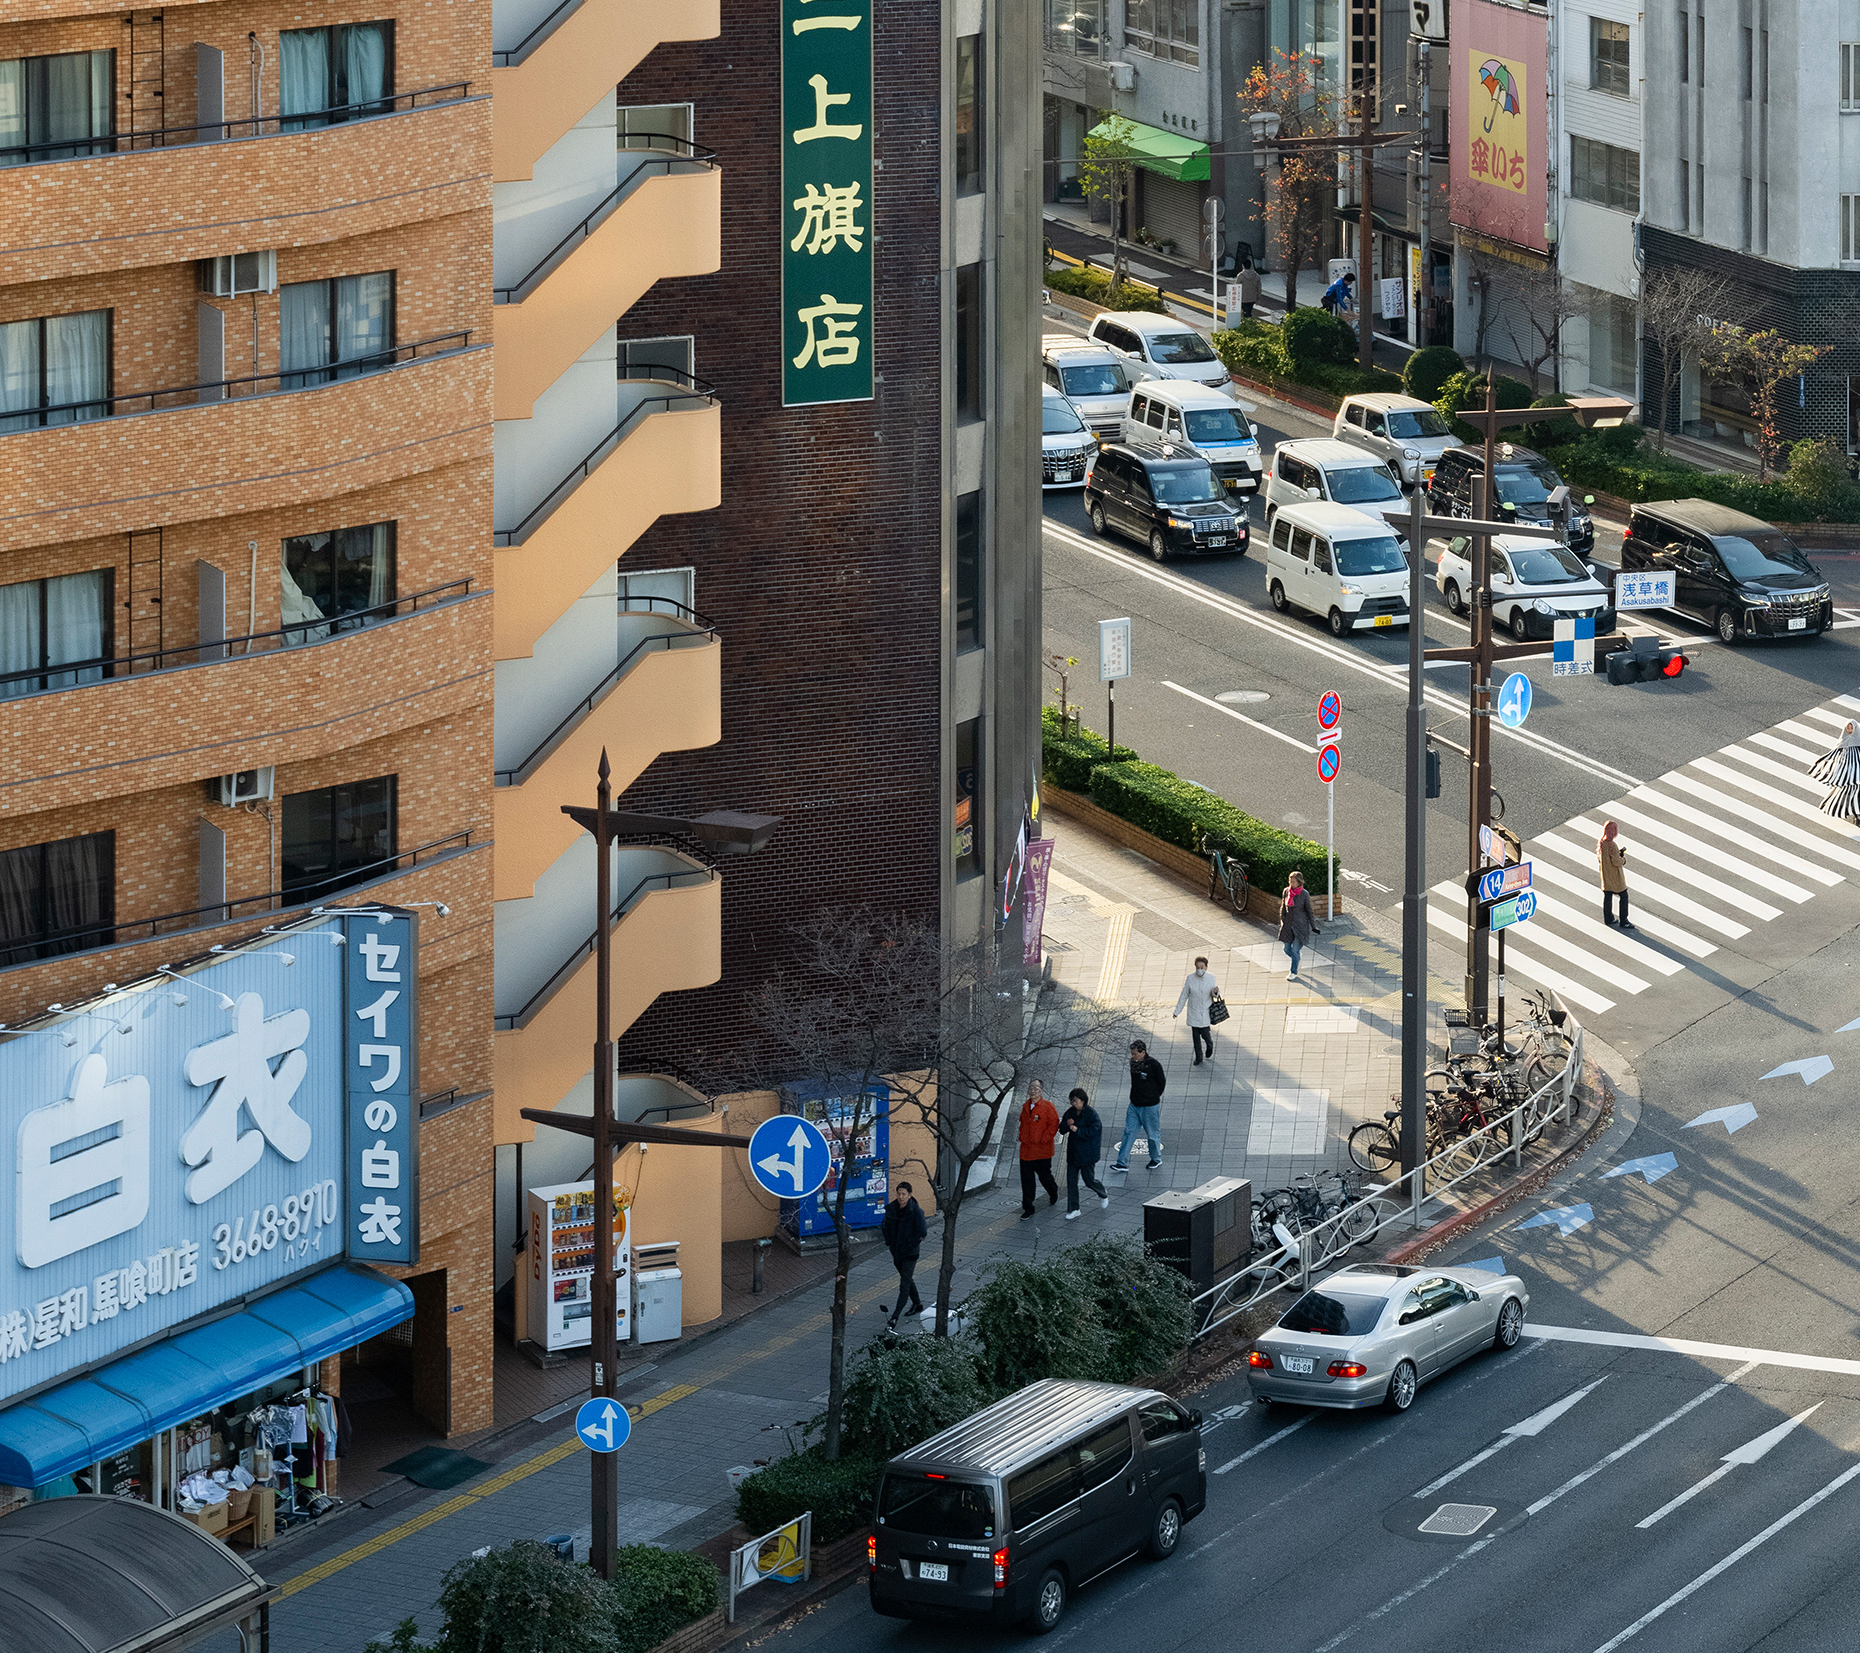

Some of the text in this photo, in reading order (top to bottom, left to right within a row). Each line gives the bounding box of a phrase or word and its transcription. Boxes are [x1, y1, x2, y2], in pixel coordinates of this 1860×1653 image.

[1471, 137, 1525, 190] 傘いち
[1623, 574, 1647, 582] 中央区
[1622, 581, 1669, 597] 浅草橋
[1621, 596, 1669, 607] Asakusabashi
[1554, 660, 1594, 676] 時差式
[1489, 873, 1502, 893] 14
[1516, 899, 1531, 918] 302
[356, 933, 403, 1246] セイワの白衣
[16, 992, 313, 1269] 白衣
[211, 1177, 338, 1271] 3668-8910
[284, 1232, 323, 1265] ハクイ
[90, 1239, 200, 1325] 馬喰町店
[925, 1568, 947, 1580] 74-93
